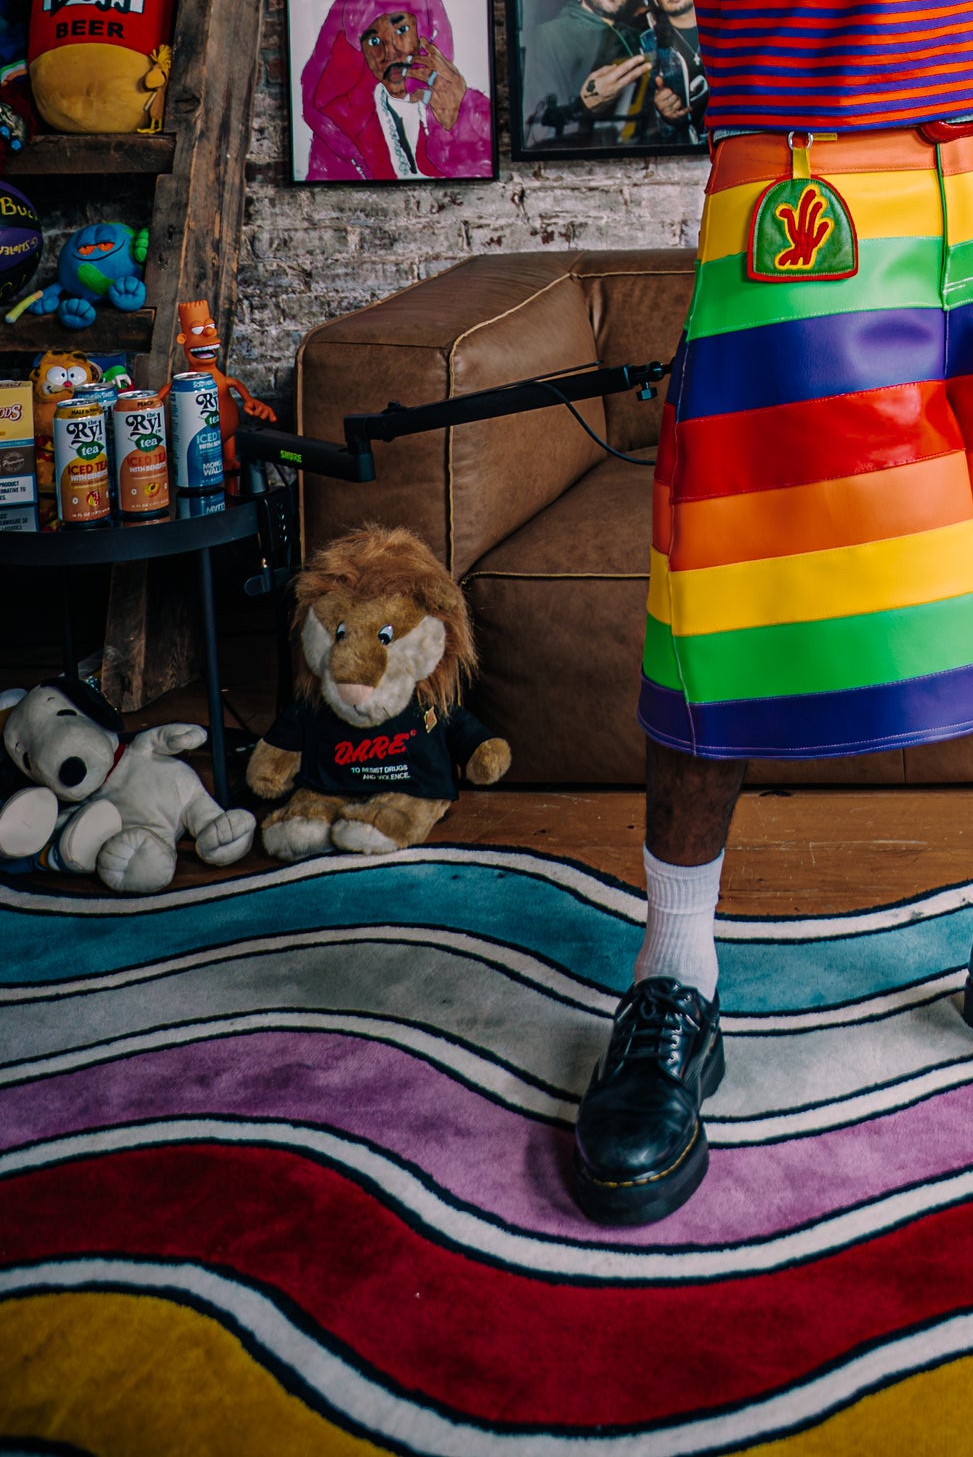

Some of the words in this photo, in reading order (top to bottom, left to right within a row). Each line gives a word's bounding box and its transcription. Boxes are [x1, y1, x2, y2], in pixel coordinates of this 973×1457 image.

[56, 19, 124, 39] BEER
[125, 412, 162, 437] Ryl
[66, 420, 103, 445] Ryl
[196, 432, 217, 444] ICED
[140, 438, 158, 448] tea
[81, 446, 100, 456] tea
[280, 449, 303, 463] SHURE
[127, 455, 152, 466] ICED
[68, 463, 94, 475] ICED
[384, 764, 408, 773] DRUGS
